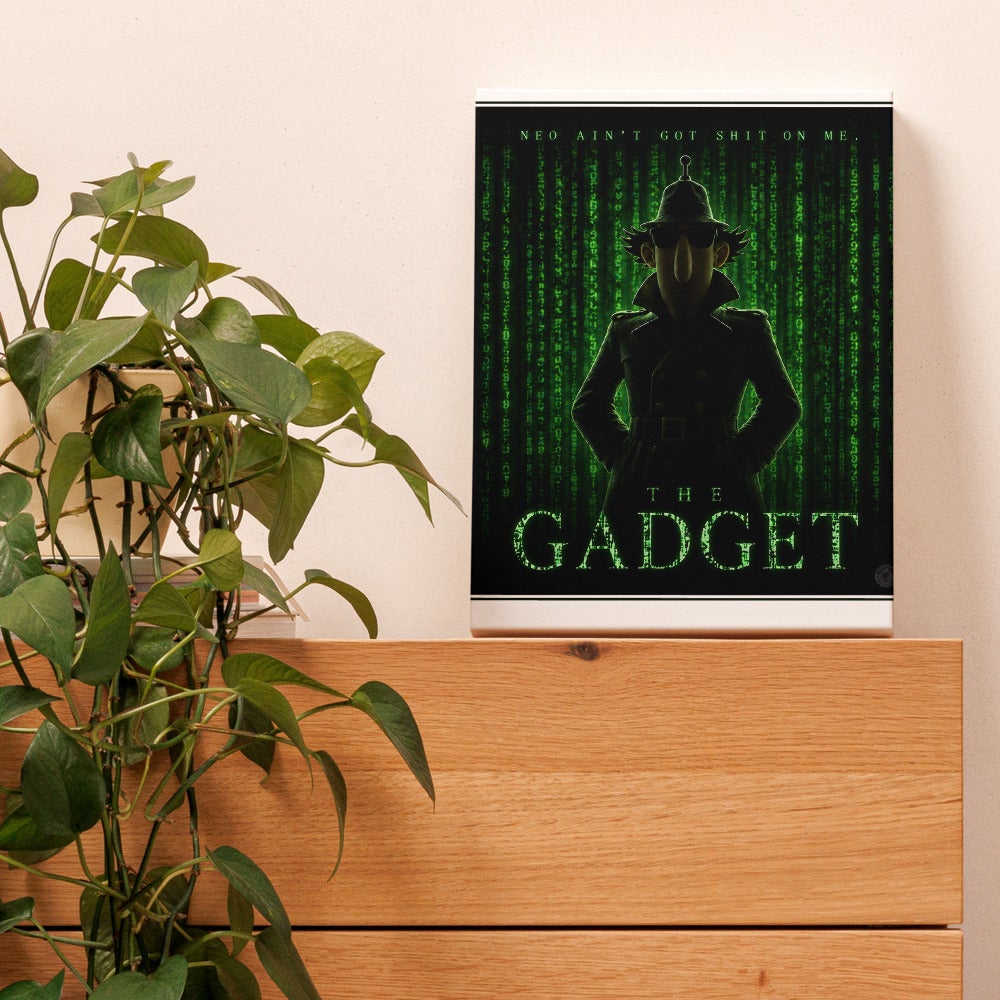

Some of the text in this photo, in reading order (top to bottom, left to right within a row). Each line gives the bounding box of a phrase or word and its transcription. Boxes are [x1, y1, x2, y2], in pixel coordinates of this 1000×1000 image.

[520, 130, 859, 141] NEO AIN'T GOT SHIT ON ME.
[646, 487, 723, 502] THE
[513, 510, 859, 571] GADGET
